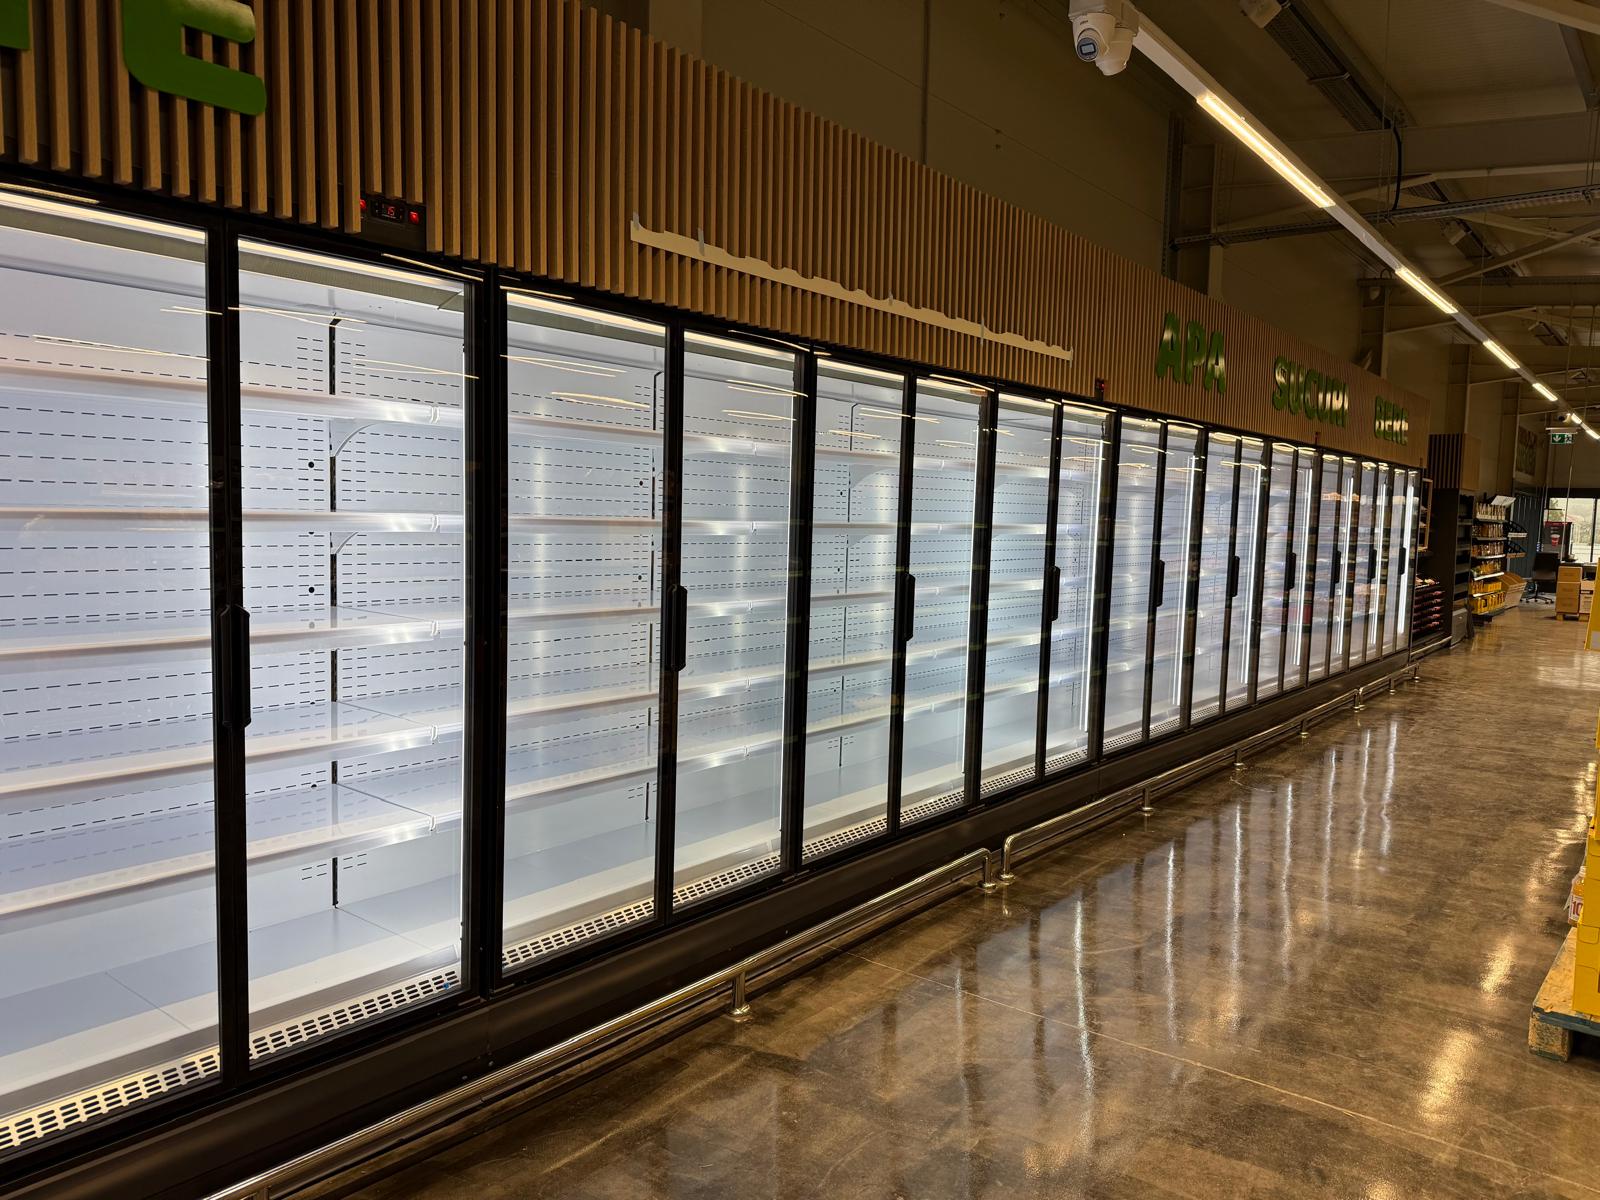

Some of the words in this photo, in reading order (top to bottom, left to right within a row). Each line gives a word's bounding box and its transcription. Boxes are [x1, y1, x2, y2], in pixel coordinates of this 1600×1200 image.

[1156, 312, 1226, 394] APA
[1272, 355, 1349, 428] SUCURI
[1374, 396, 1409, 446] BERE
